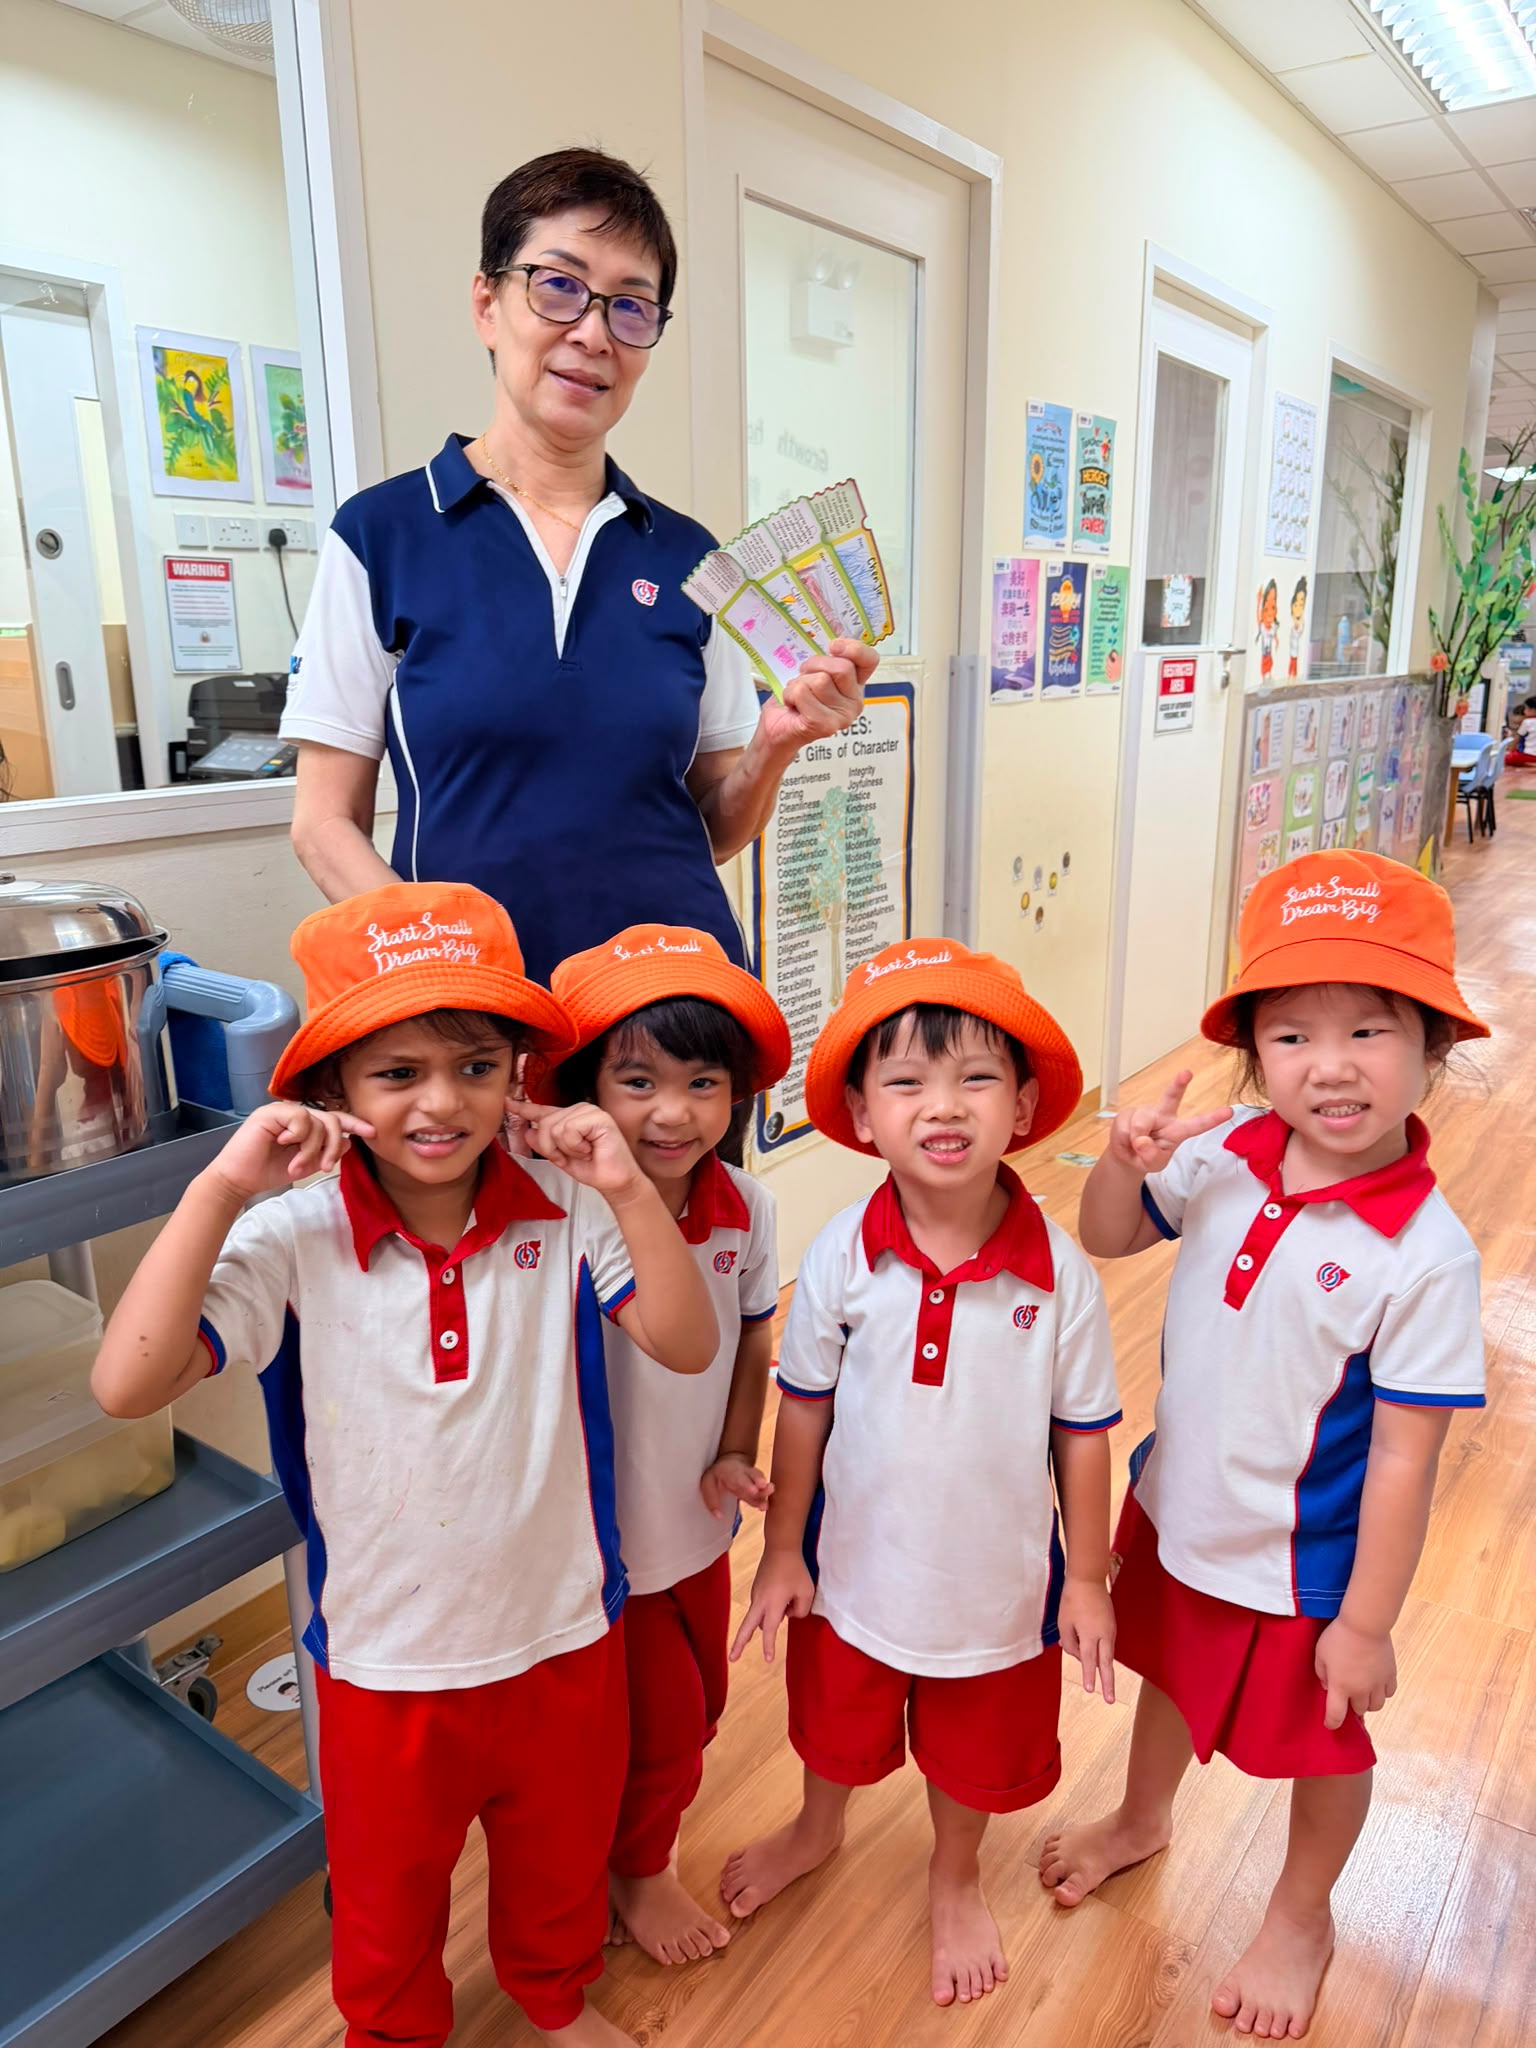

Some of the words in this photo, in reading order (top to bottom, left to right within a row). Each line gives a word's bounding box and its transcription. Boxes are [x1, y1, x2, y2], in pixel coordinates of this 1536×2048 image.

[171, 562, 226, 578] WARNING
[805, 745, 832, 762] Gifts
[837, 743, 848, 758] of
[852, 739, 899, 756] Character
[848, 765, 876, 778] Integrity
[847, 778, 883, 792] Joyfulness
[779, 789, 803, 801] Caring
[779, 800, 820, 814] Cleanliness
[846, 802, 877, 814] Kindness
[778, 811, 823, 826] Commitment
[845, 815, 861, 826] Love
[777, 824, 822, 839] Compassion
[777, 838, 818, 852] Confidence
[777, 848, 828, 866] Consideration
[777, 863, 822, 879] Cooperation
[778, 878, 810, 891] Courage
[1325, 875, 1380, 898] Small
[777, 890, 811, 904] Courtesy
[777, 902, 811, 917] Creativity
[1280, 902, 1342, 927] Dream
[1341, 899, 1382, 924] Big
[365, 923, 421, 952] Start
[419, 911, 472, 941] Small
[777, 922, 826, 943] Determination
[656, 936, 702, 953] Small
[777, 940, 809, 956] Diligence
[845, 934, 873, 948] Respect
[373, 947, 442, 975] Dream
[440, 938, 481, 965] Big
[777, 949, 818, 968] Enthusiasm
[903, 948, 953, 970] Small
[777, 964, 815, 982] Excellence
[777, 978, 812, 996] Flexibility
